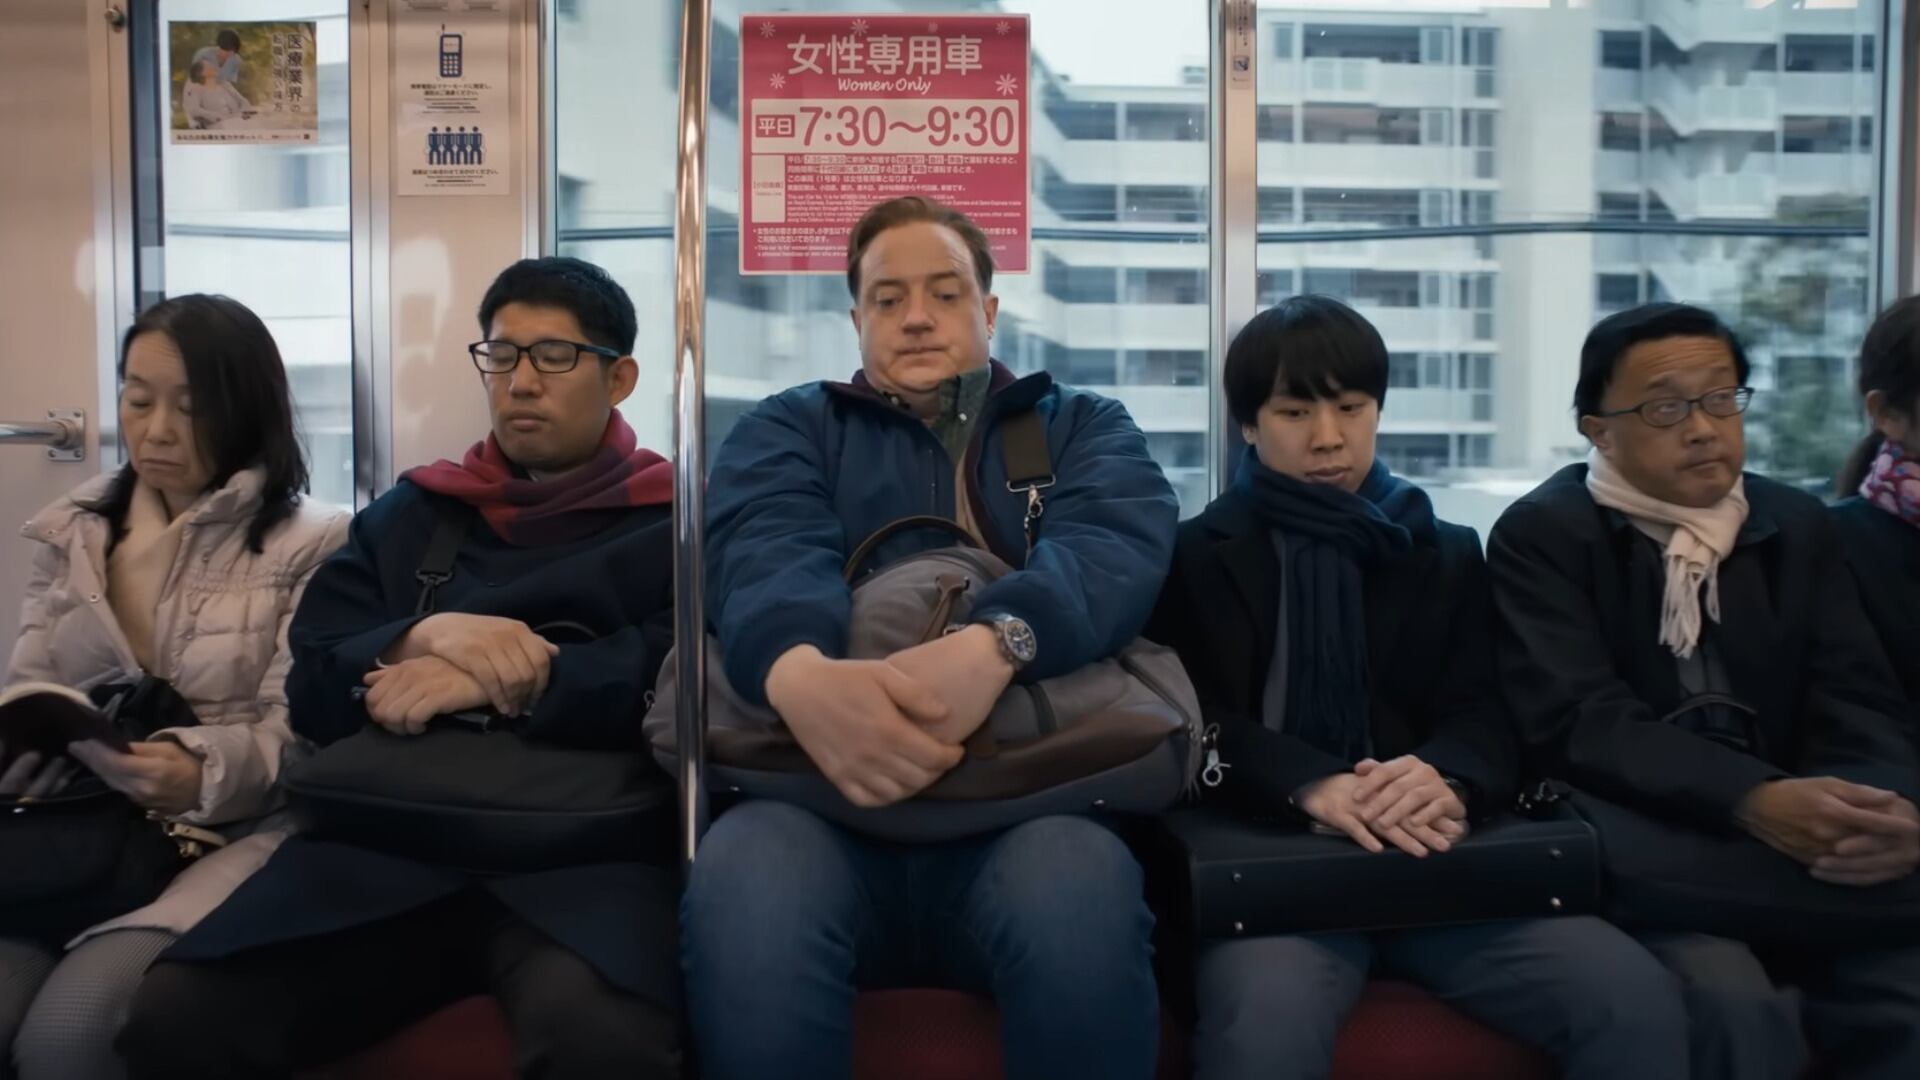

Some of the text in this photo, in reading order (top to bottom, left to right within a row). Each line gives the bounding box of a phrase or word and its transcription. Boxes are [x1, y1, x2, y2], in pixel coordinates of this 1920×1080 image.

[287, 33, 303, 112] 医療業界の
[787, 34, 983, 76] 女性専用車
[838, 76, 932, 95] Women Only
[758, 105, 1014, 147] 平日 7:30〜9:30
